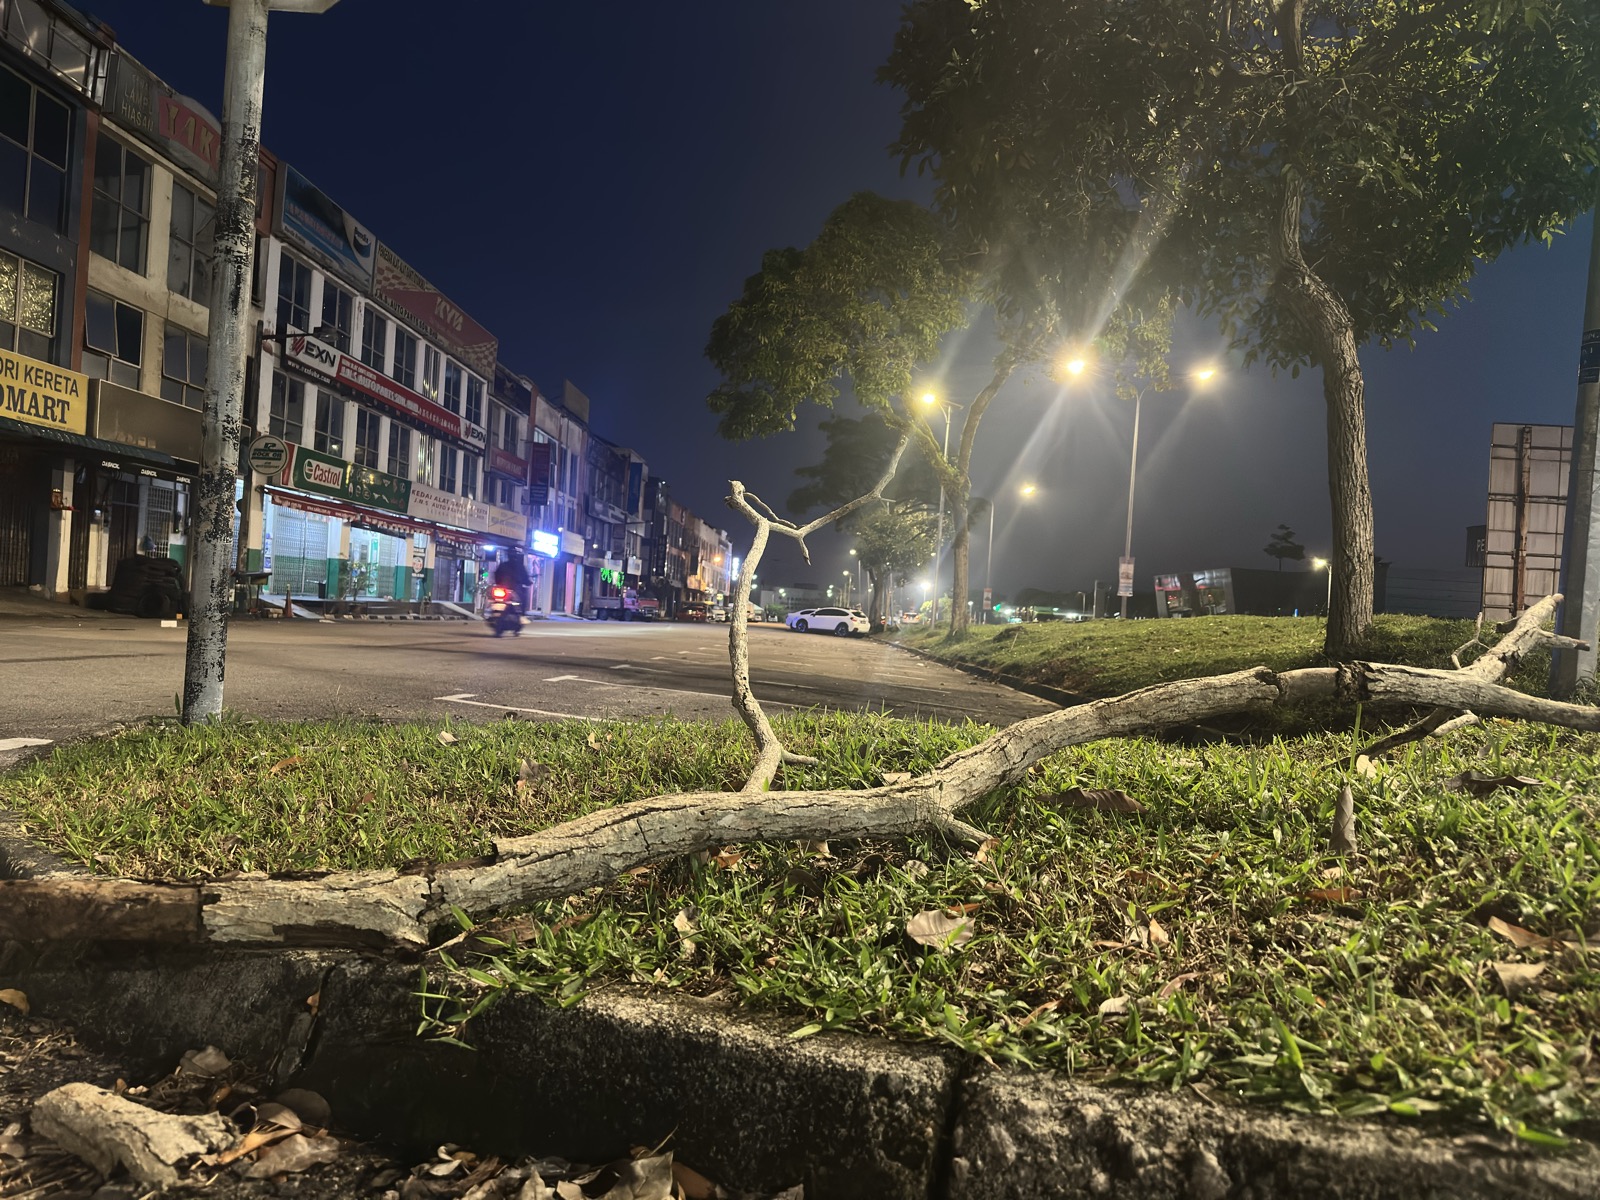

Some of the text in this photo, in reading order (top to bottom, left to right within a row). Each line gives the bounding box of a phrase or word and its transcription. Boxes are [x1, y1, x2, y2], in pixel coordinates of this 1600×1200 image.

[390, 301, 404, 316] AUTO
[304, 341, 337, 368] EXN
[24, 364, 79, 398] KERETA
[0, 383, 70, 424] MART
[313, 464, 341, 486] Castrol
[412, 489, 433, 500] KEDAI
[434, 496, 450, 504] ALAT
